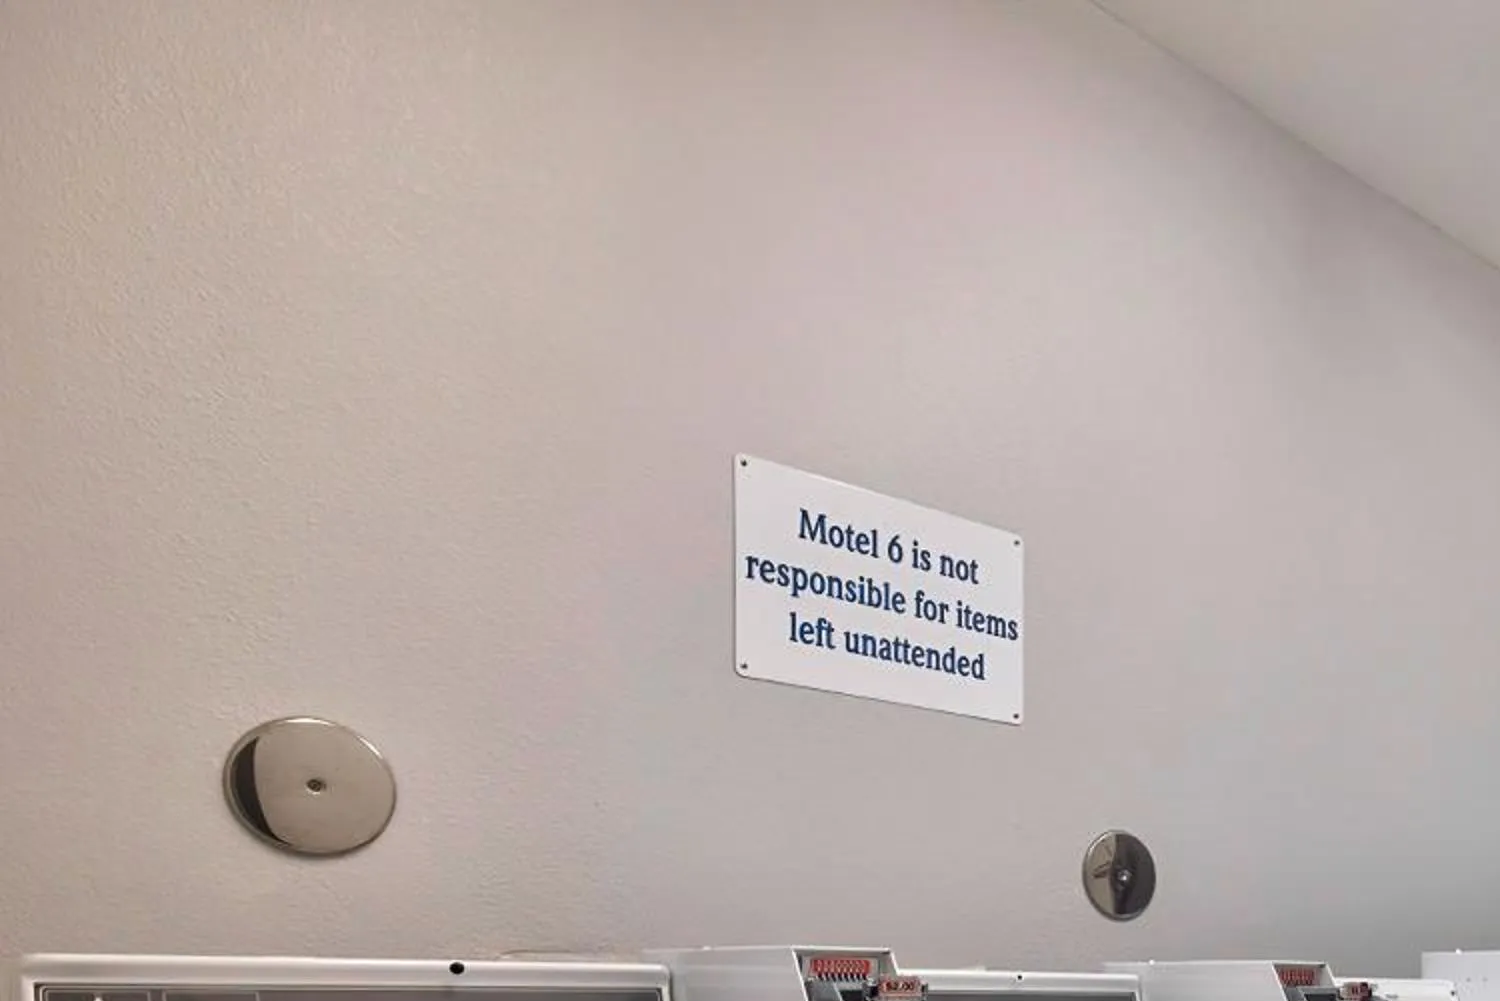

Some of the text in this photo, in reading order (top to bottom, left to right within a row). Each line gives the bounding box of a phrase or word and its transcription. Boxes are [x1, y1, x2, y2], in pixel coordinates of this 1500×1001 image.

[798, 507, 979, 584] Motel 6 is not
[745, 555, 1019, 641] responsible for items
[789, 611, 986, 680] left unattended
